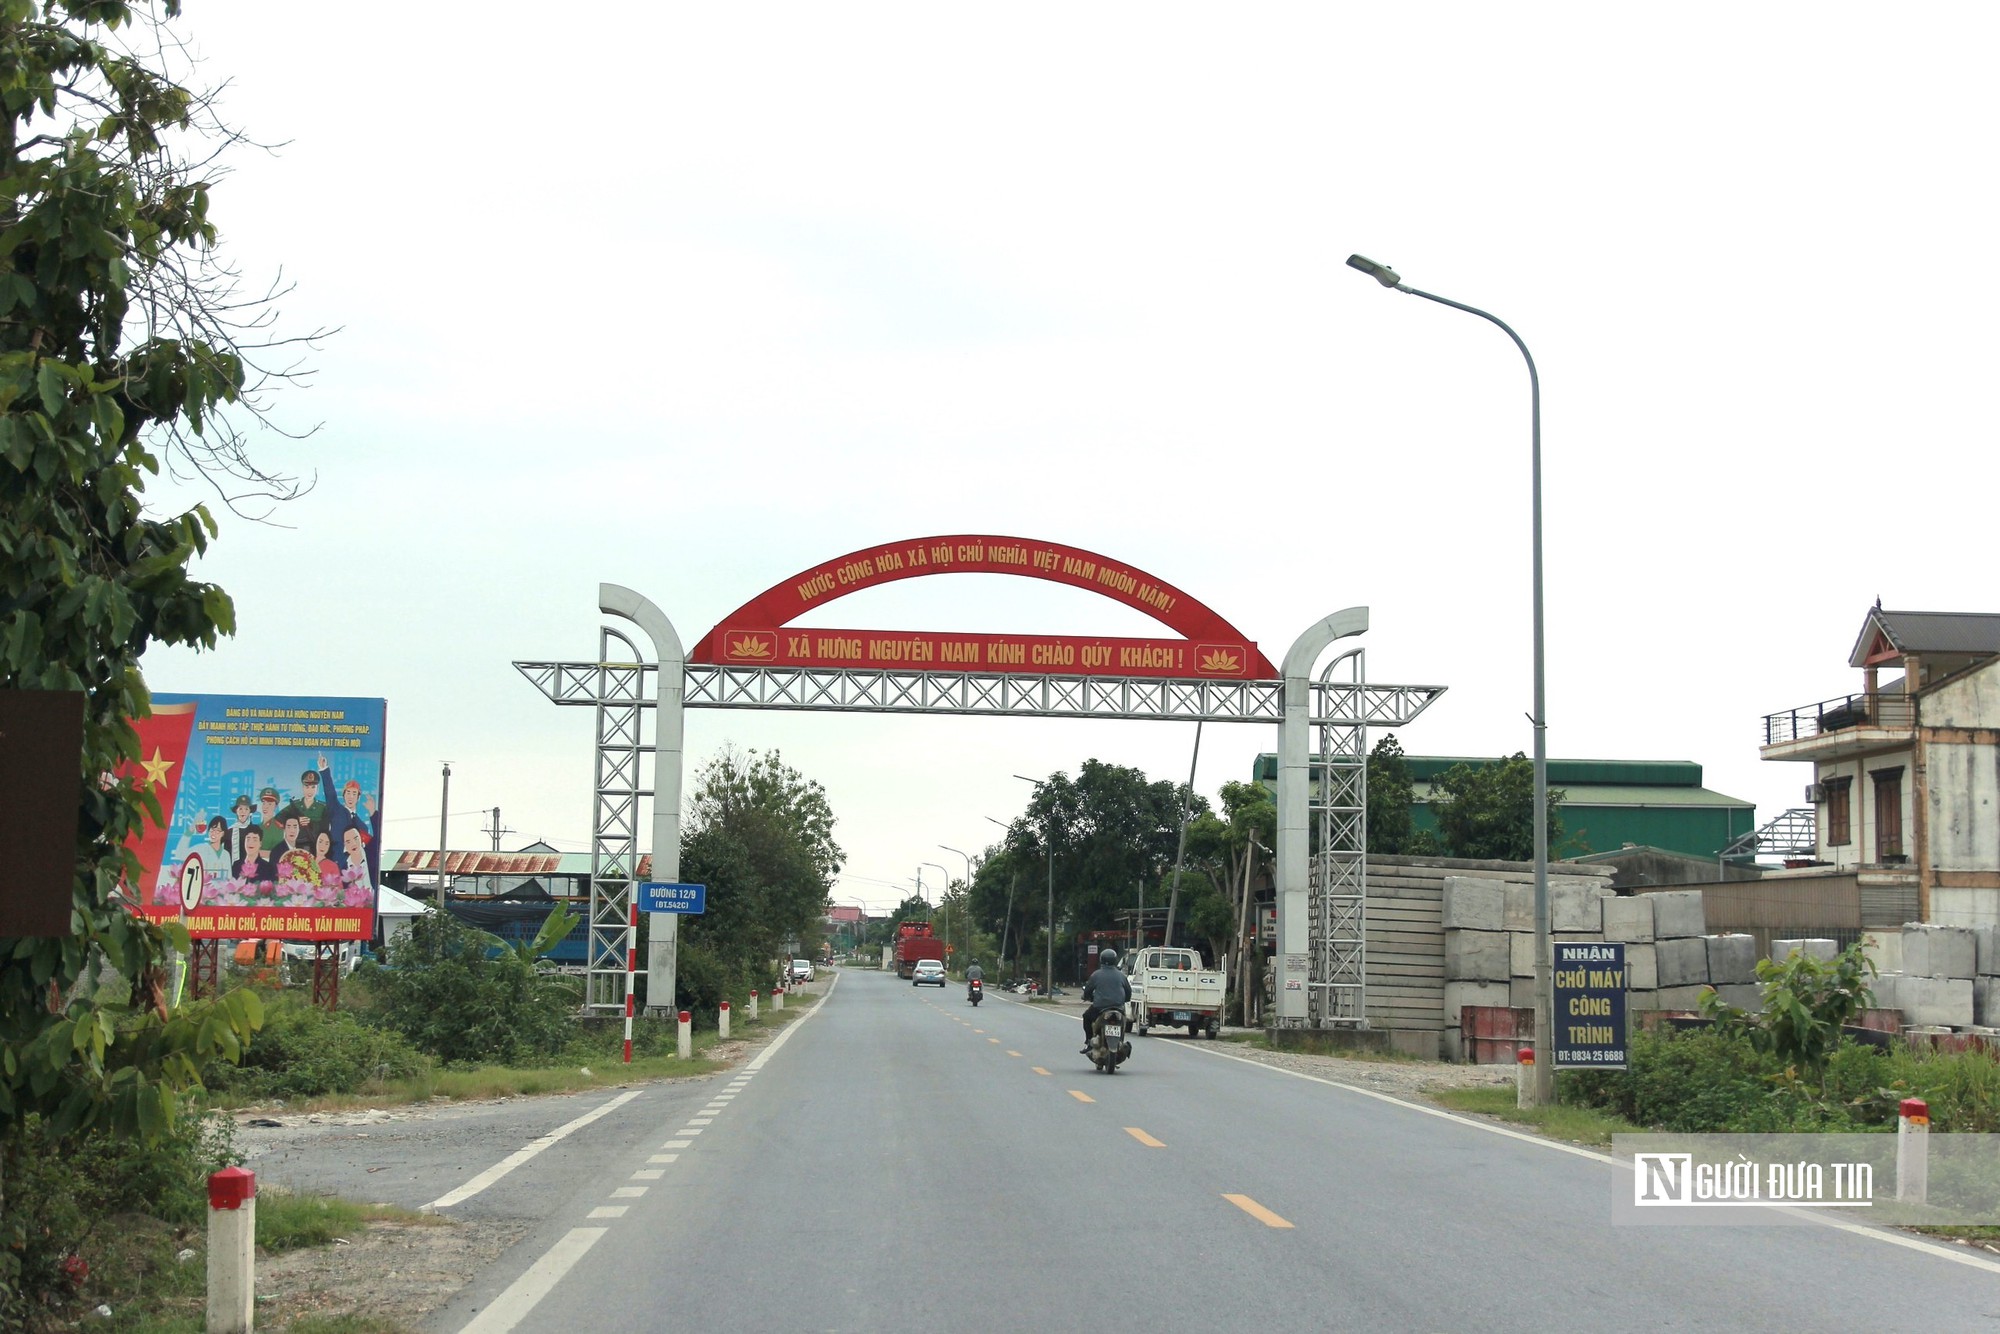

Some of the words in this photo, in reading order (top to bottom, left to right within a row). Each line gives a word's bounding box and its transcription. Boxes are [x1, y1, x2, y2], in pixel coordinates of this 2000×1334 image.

[798, 570, 836, 601] NƯỚC
[837, 559, 873, 585] CỘNG
[876, 550, 904, 574] HÒA
[907, 543, 928, 567] XÃ
[932, 542, 954, 567] HỘI
[957, 539, 984, 562] CHỦ
[988, 543, 1028, 566] NGHĨA
[1033, 549, 1061, 573] VIỆT
[1063, 557, 1096, 580] NAM
[1097, 570, 1137, 595] MUÔN
[1137, 584, 1176, 614] NĂM!
[787, 634, 811, 658] XÃ
[818, 637, 862, 660] HƯNG
[869, 637, 933, 662] NGUYÊN
[941, 642, 979, 663] NAM
[987, 639, 1026, 664] KÍNH
[1032, 640, 1075, 666] CHÀO
[650, 886, 677, 898] ĐƯỜNG
[679, 889, 696, 899] 12/9
[187, 916, 215, 933] MẠNH,
[218, 914, 236, 931] DÂN
[238, 912, 258, 932] CHỦ,
[261, 914, 285, 931] CÔNG
[286, 912, 313, 933] BẰNG,
[315, 915, 332, 932] VĂN
[335, 917, 361, 932] MINH!
[1562, 945, 1615, 962] NHẬN
[1555, 964, 1586, 989] CHỞ
[1589, 966, 1623, 988] MÁY
[1569, 994, 1611, 1016] CÔNG
[1568, 1022, 1613, 1044] TRÌNH
[1571, 1050, 1591, 1061] 0834
[1593, 1051, 1603, 1061] 25
[1604, 1050, 1624, 1061] 6688
